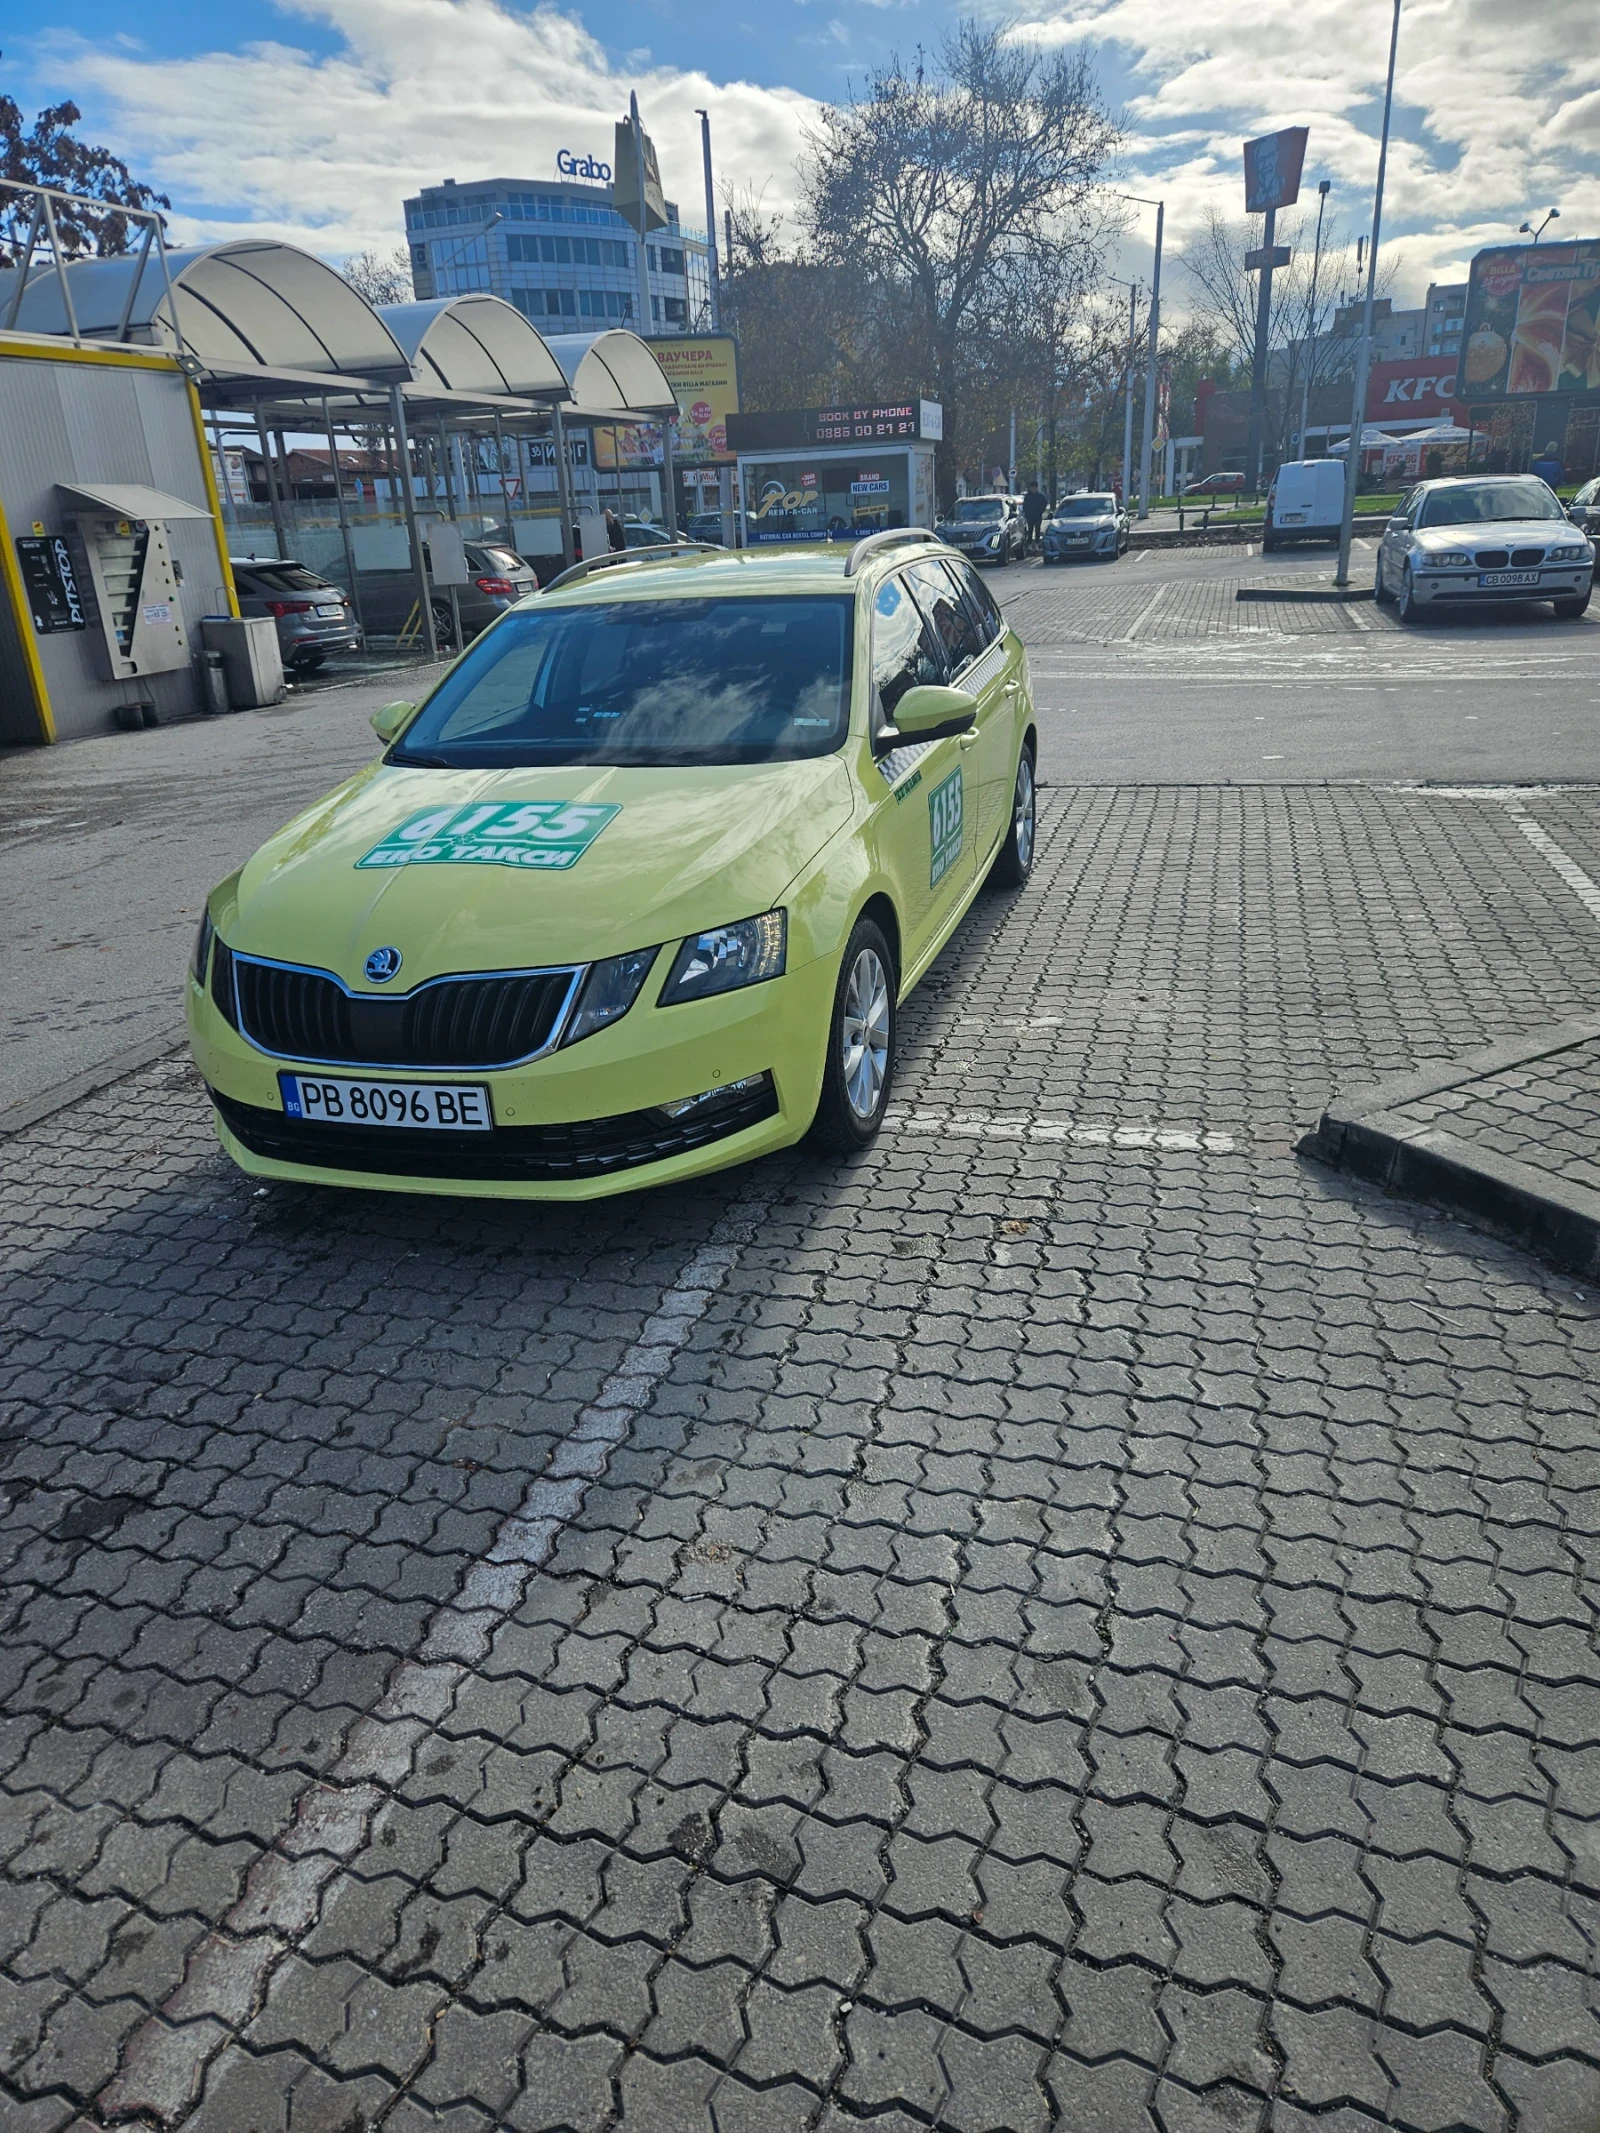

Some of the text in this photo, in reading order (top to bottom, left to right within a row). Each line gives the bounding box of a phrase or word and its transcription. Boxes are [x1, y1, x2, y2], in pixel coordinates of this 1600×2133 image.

[557, 149, 611, 181] Grabo
[1490, 264, 1516, 275] BILLA
[657, 350, 713, 362] ВАУЧЕРА
[1383, 375, 1456, 403] KFC
[819, 407, 912, 422] BOOK BY PHONE
[855, 425, 872, 436] 00
[852, 482, 888, 492] NEW CARS
[757, 491, 818, 519] TOP
[768, 508, 818, 516] RENT-A-CAR
[54, 539, 85, 624] PITSTOP
[1486, 573, 1537, 584] CB 0098 AX
[933, 774, 961, 849] 6155
[398, 804, 608, 841] 6155
[361, 844, 576, 866] ЕКО ТАКСИ
[287, 1101, 300, 1112] BG
[301, 1082, 483, 1125] PB 8096 BE
